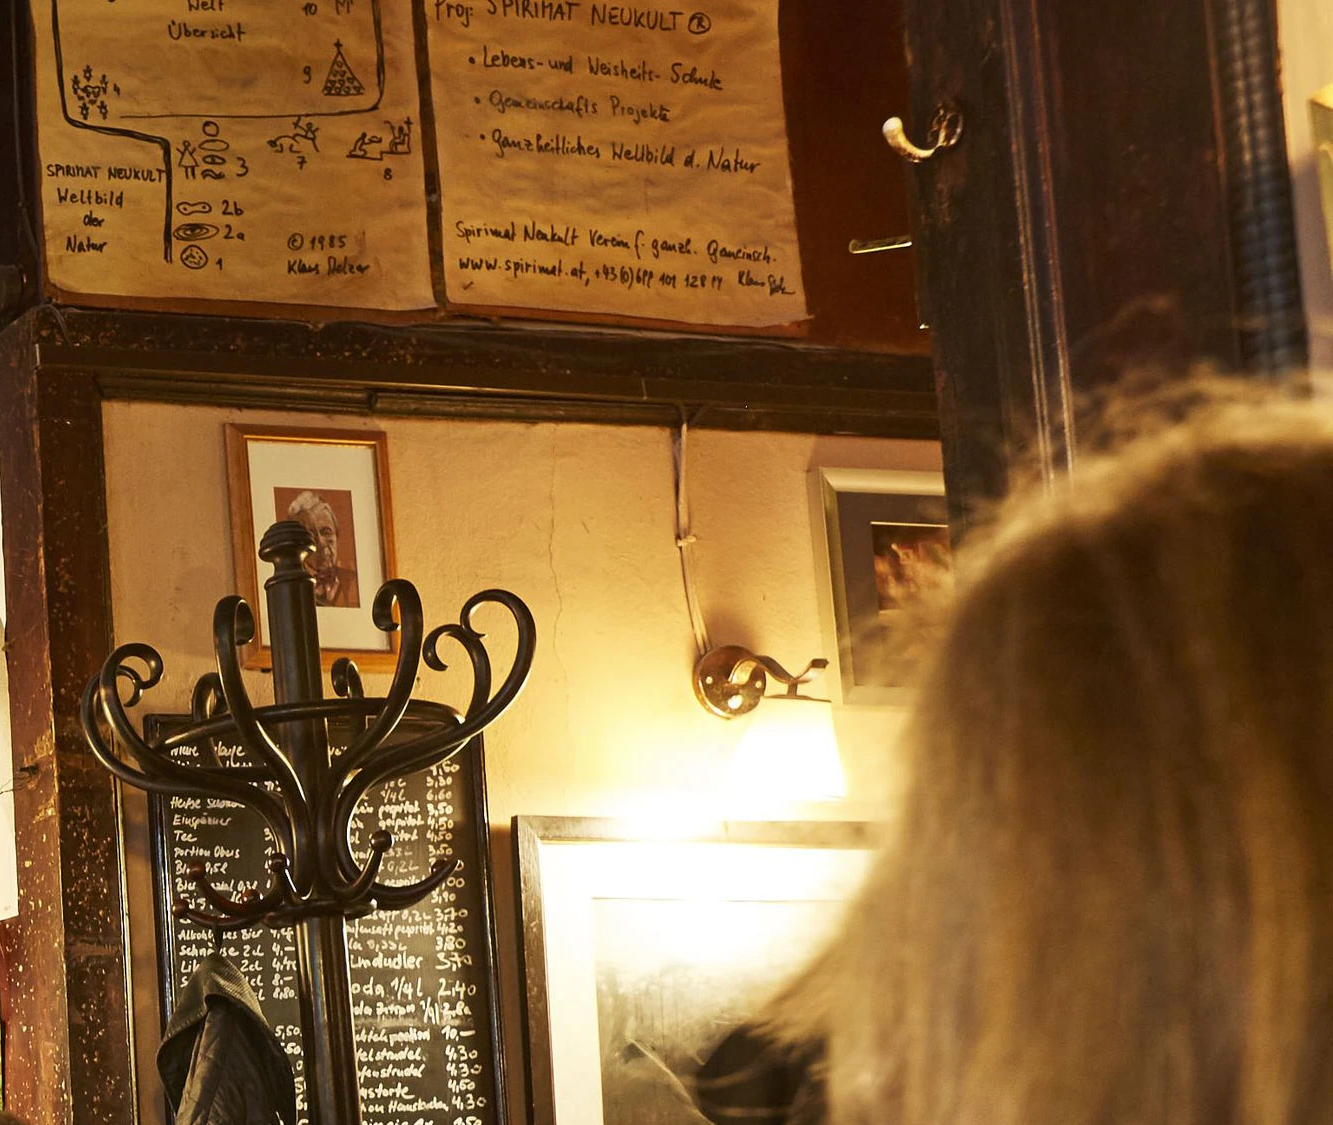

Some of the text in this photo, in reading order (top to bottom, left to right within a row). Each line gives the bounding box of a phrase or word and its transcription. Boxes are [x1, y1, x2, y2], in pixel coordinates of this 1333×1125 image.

[591, 4, 683, 32] NEUKULT
[168, 20, 246, 42] Übersicht
[708, 149, 760, 173] Natur
[57, 188, 123, 208] Weltbild
[66, 239, 107, 253] Natur
